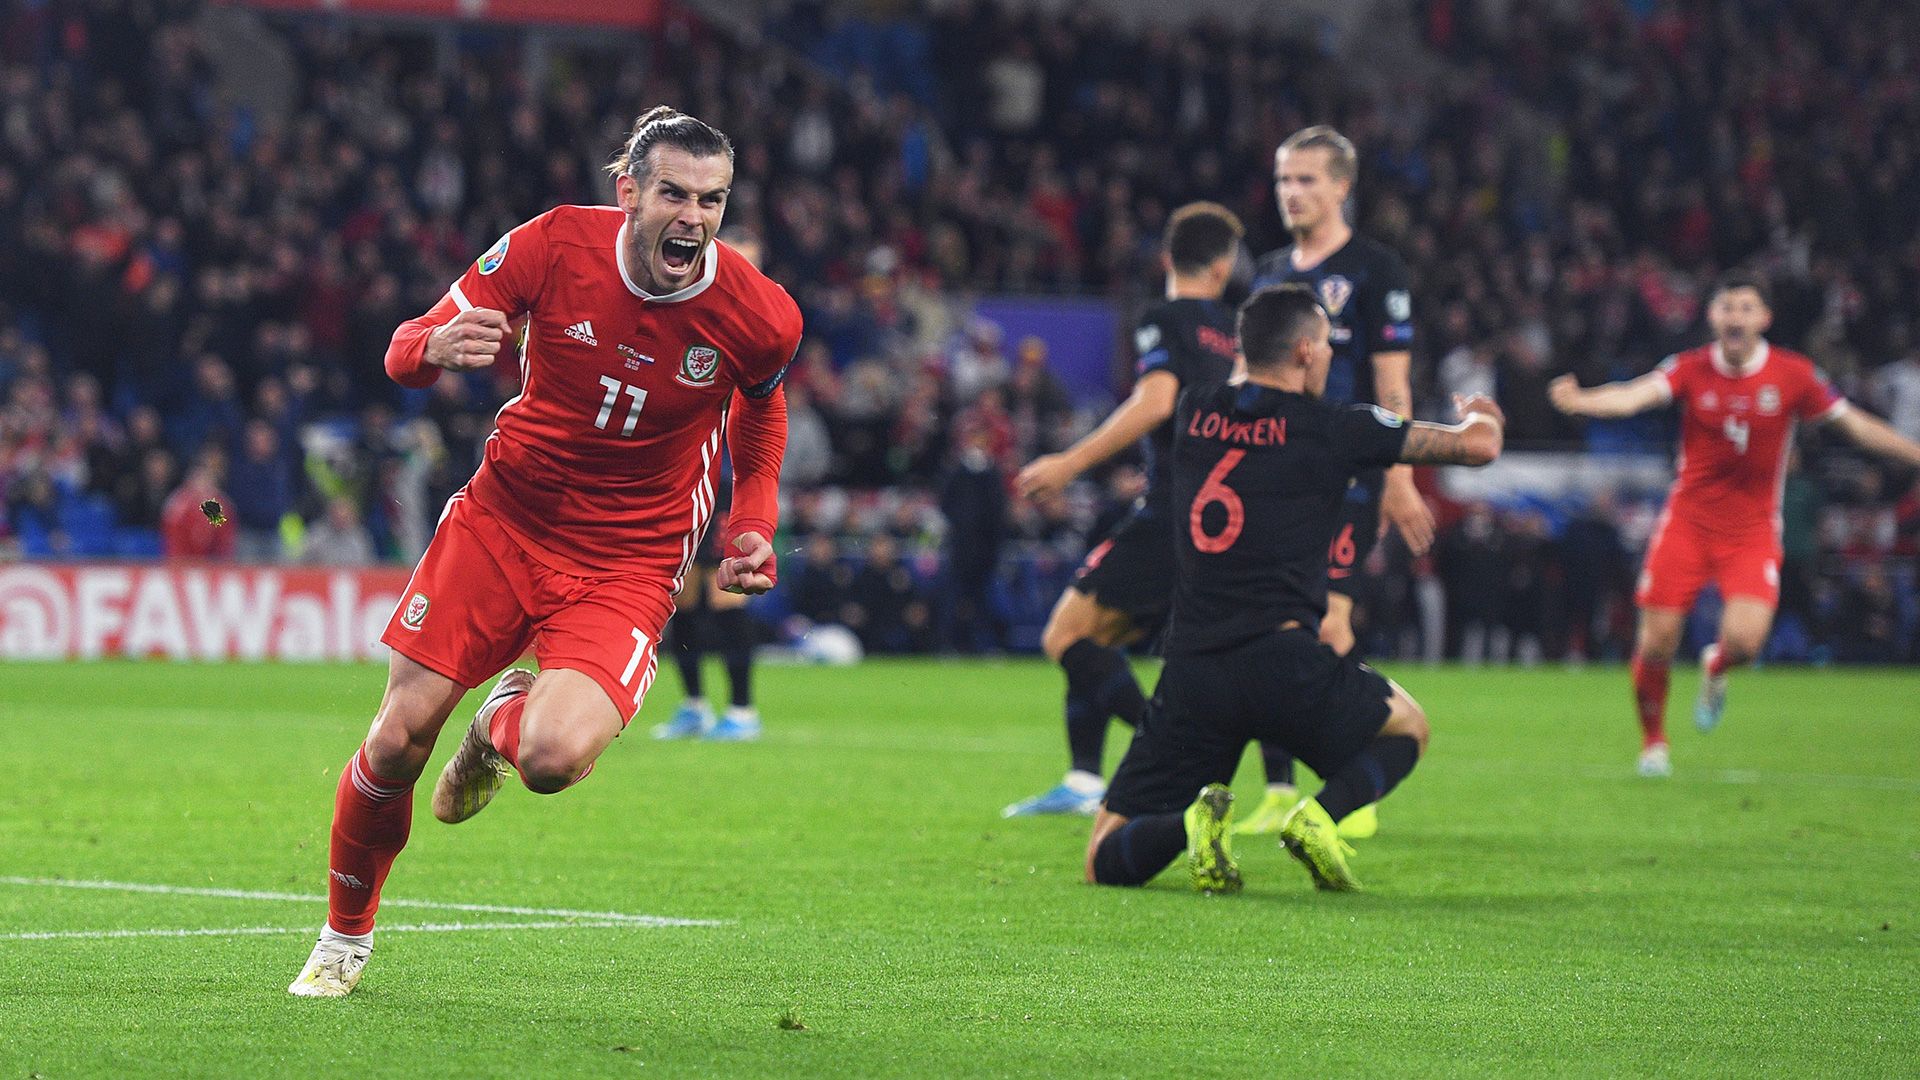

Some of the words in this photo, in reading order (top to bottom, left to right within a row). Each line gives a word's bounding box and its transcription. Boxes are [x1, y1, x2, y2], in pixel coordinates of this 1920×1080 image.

[564, 328, 598, 347] adidas
[594, 375, 649, 437] 11
[1189, 409, 1288, 446] LOVREN
[1723, 413, 1750, 456] 4
[1189, 447, 1248, 554] 6
